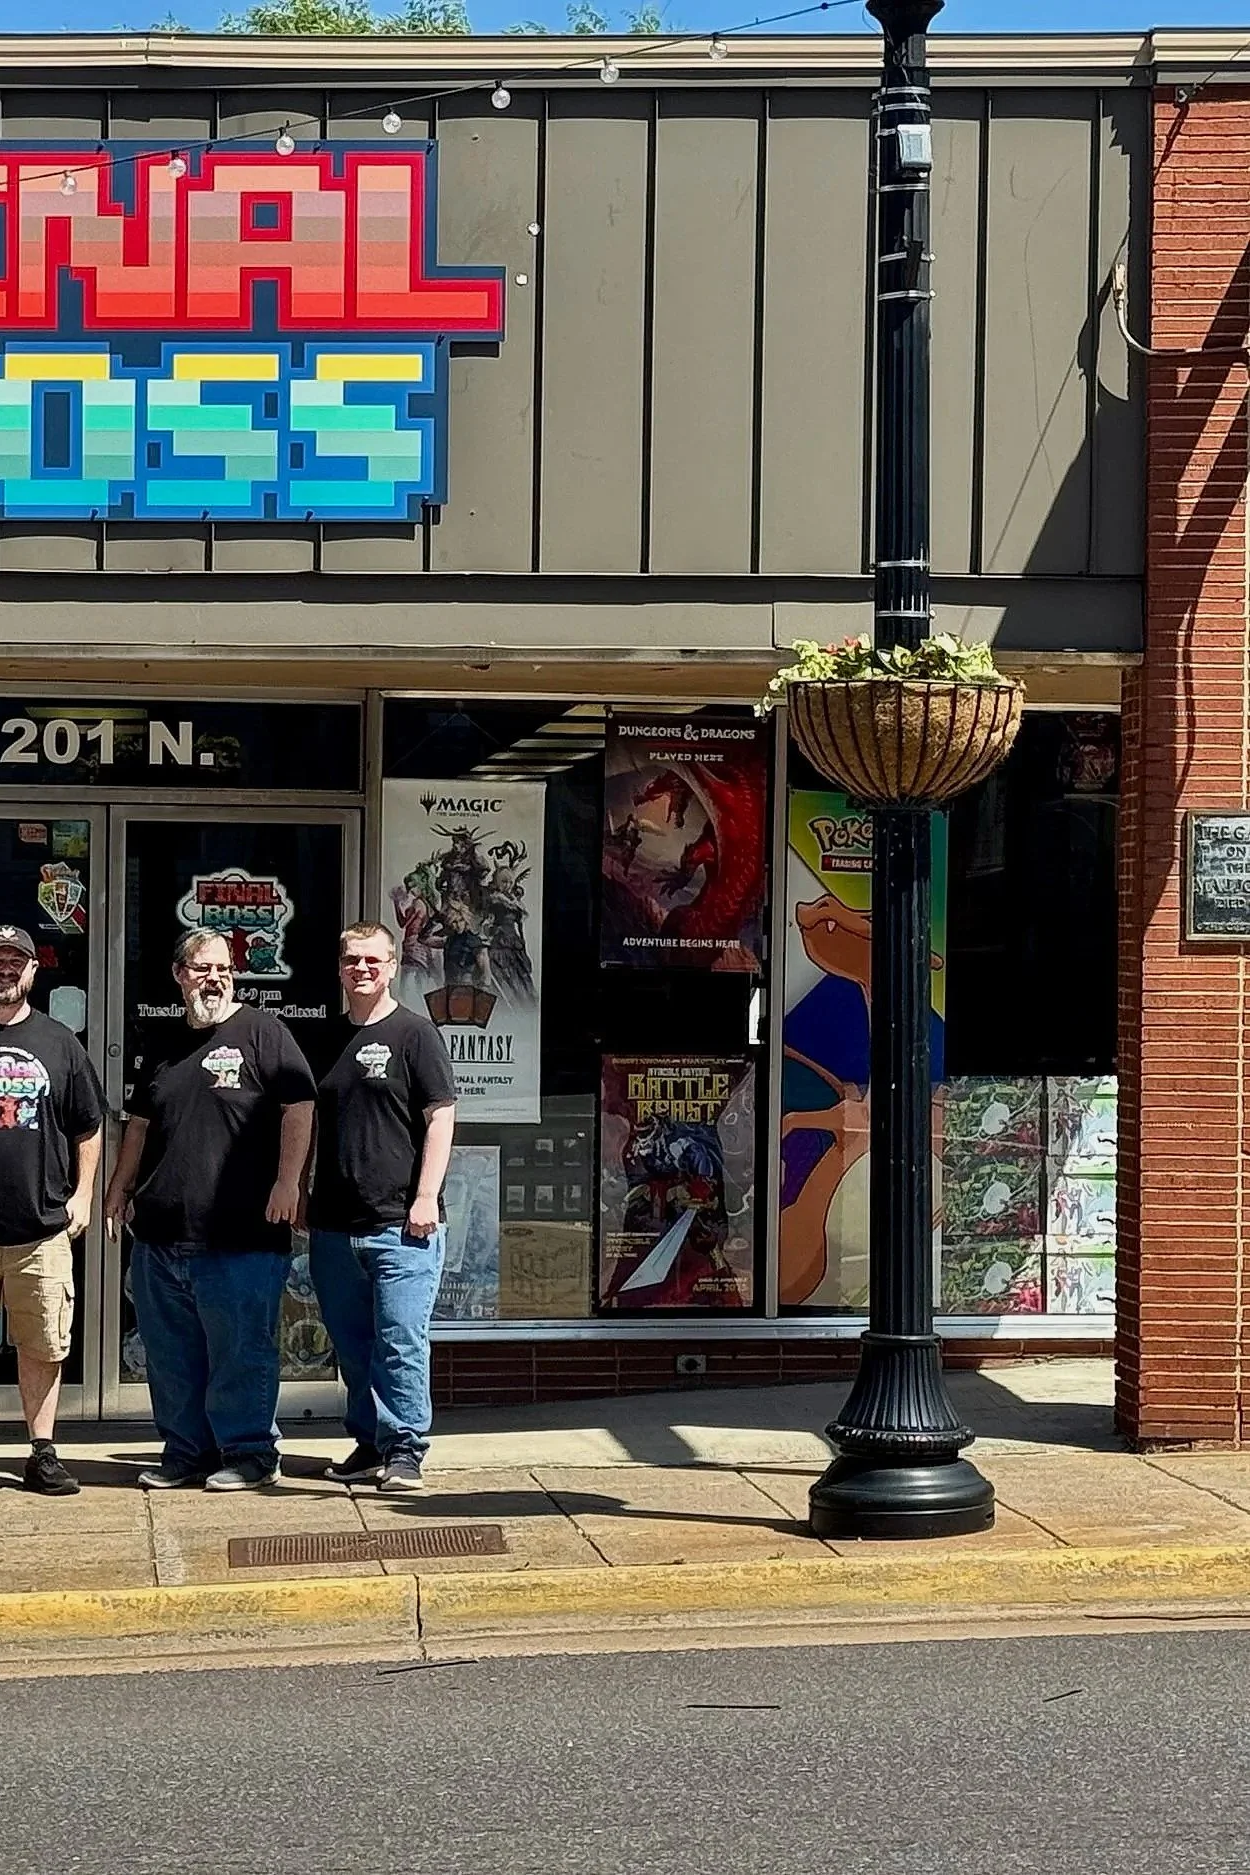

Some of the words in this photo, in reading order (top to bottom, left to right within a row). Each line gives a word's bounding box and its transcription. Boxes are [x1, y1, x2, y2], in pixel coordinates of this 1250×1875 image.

[618, 725, 681, 738] DUNGEONS
[683, 724, 699, 741] &
[701, 728, 756, 740] DRAGONS
[0, 718, 114, 765] 201
[149, 720, 215, 766] N.
[649, 752, 692, 761] PLAYED
[694, 754, 724, 762] HERE
[436, 797, 503, 813] MAGIC
[196, 882, 279, 903] FINAL
[203, 905, 273, 925] BOSS
[622, 937, 678, 948] ADVENTURE
[680, 938, 713, 949] BEGINS
[715, 939, 741, 949] HERE
[260, 990, 282, 1004] pm
[450, 1034, 513, 1061] FANTASY
[477, 1075, 513, 1085] FANTASY
[628, 1073, 731, 1100] BATTLE
[636, 1100, 722, 1125] BEAST
[693, 1283, 722, 1293] APRIL
